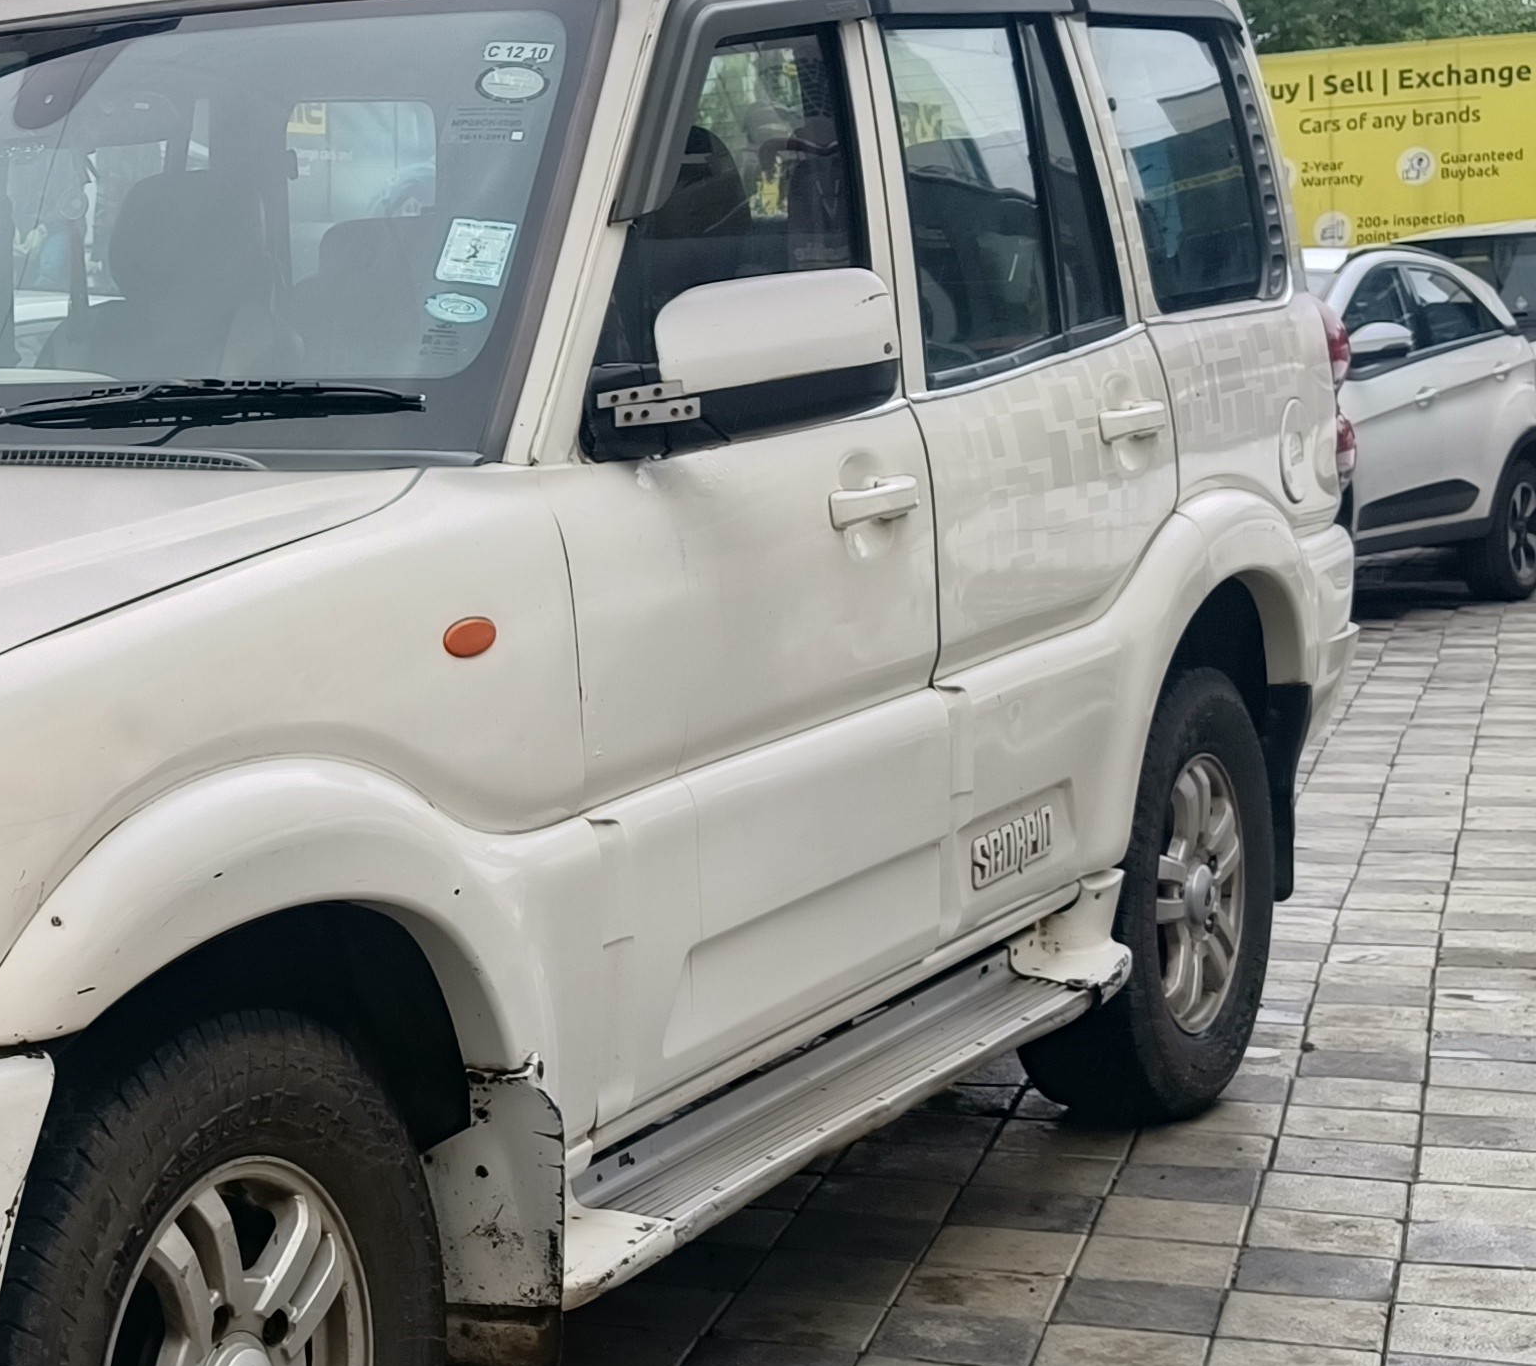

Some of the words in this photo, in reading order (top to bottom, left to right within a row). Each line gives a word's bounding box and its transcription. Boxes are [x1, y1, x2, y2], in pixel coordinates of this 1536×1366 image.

[488, 45, 501, 58] C
[506, 46, 525, 58] 12
[530, 46, 548, 60] 10
[1264, 82, 1300, 104] uy
[1323, 70, 1373, 96] Sell
[1398, 63, 1531, 90] Exchange
[1299, 117, 1341, 135] Cars
[1346, 113, 1367, 131] of
[1372, 114, 1407, 132] any
[1412, 105, 1481, 127] brands
[1440, 148, 1524, 164] Guaranteed
[1301, 161, 1344, 173] 2-Year
[1441, 165, 1500, 181] Buyback
[1301, 173, 1363, 188] Warranty
[1393, 212, 1465, 228] inspection
